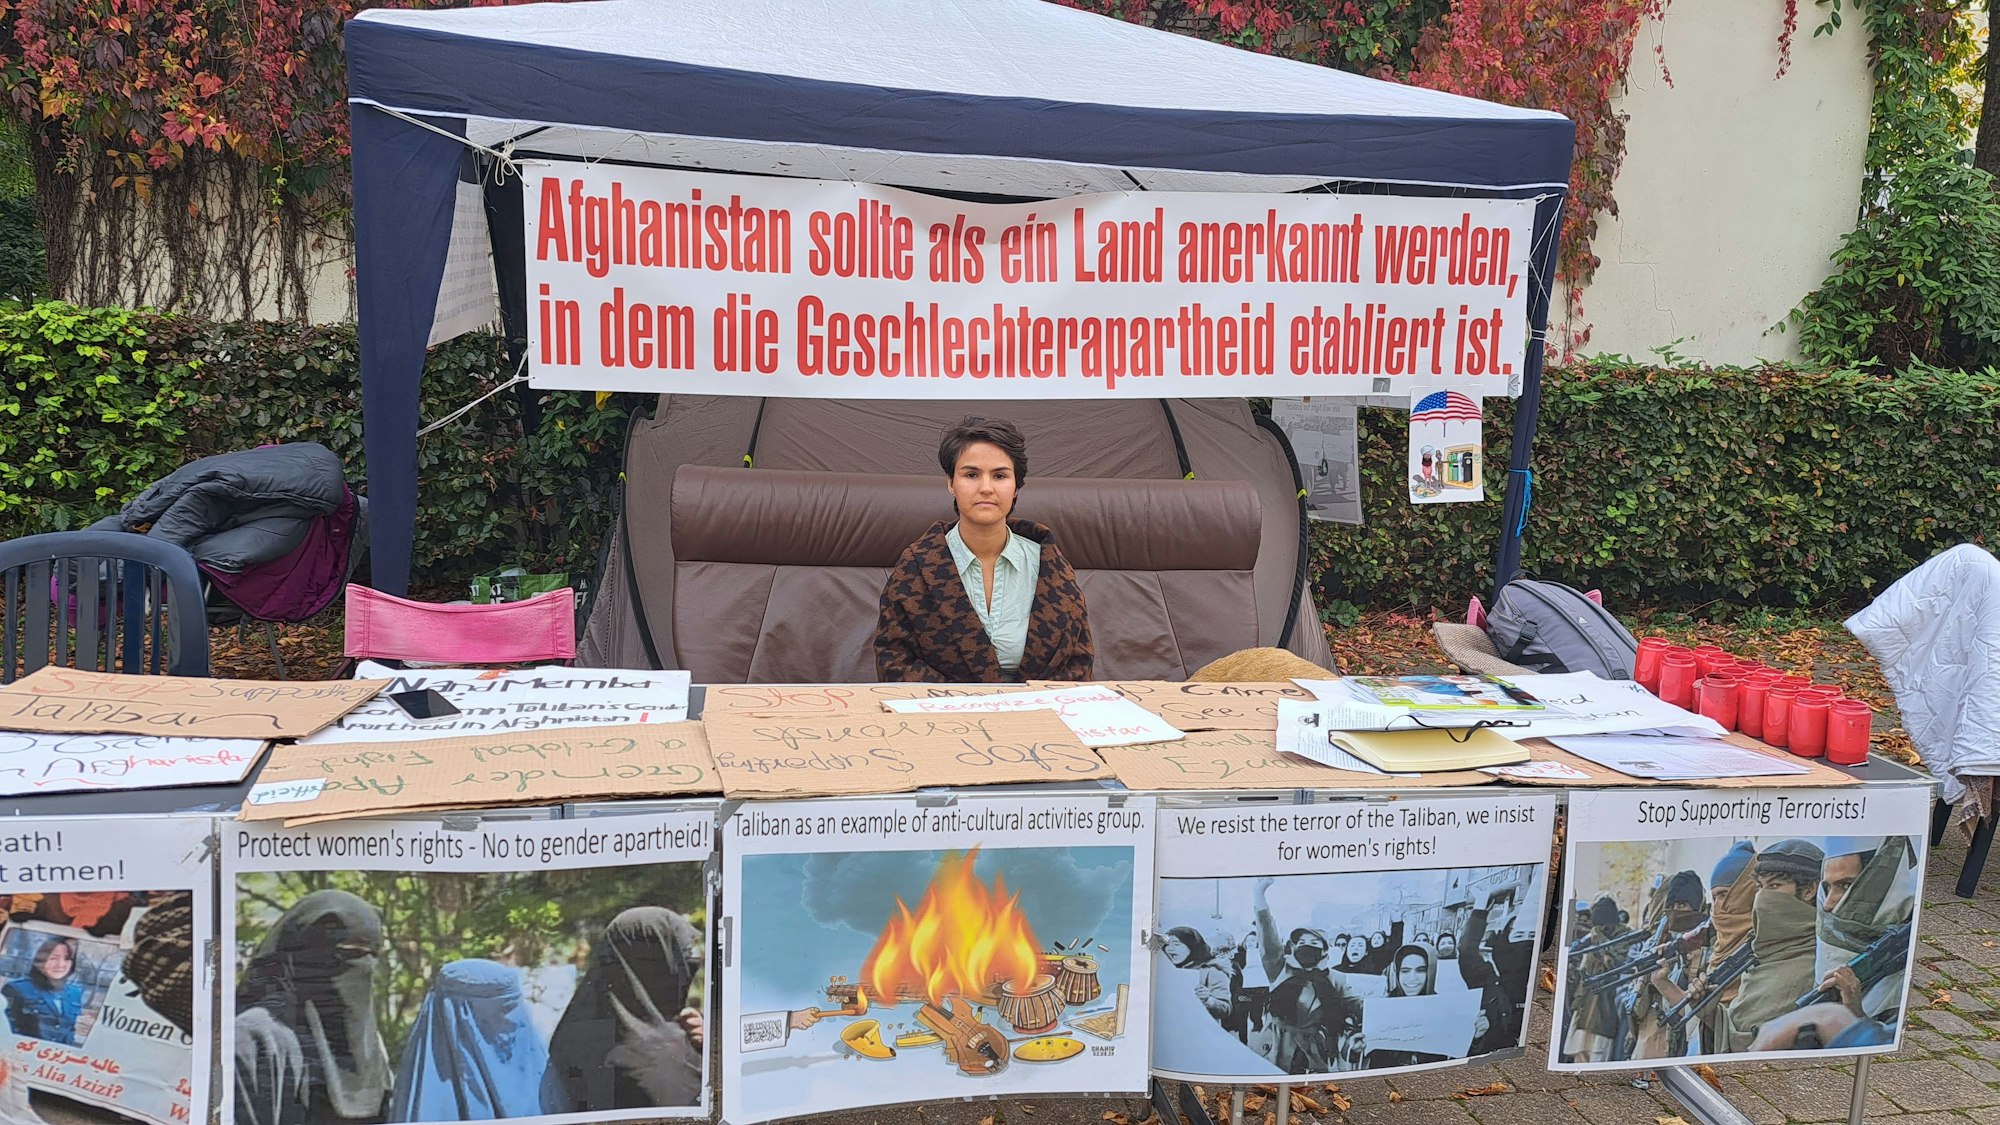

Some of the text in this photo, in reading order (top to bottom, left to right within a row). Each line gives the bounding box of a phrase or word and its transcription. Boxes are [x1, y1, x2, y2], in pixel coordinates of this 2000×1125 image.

[537, 177, 791, 278] Afghanistan
[809, 198, 914, 281] sollte
[929, 214, 986, 284] als
[1001, 213, 1057, 284] ein
[1074, 207, 1163, 283] Land
[1178, 209, 1363, 283] anerkannt
[1374, 213, 1518, 297] werden,
[539, 284, 1511, 390] in dem die Geschlechterapartheid etabliert ist.
[734, 807, 1144, 839] Taliban as an example of anti-cultural activities group.
[1178, 805, 1535, 834] We resist the terror of the Taliban, we insist
[1637, 797, 1866, 827] Stop Supporting Terrorists!
[238, 831, 311, 857] Protect
[318, 829, 404, 857] women's
[411, 831, 463, 864] rights
[483, 832, 509, 858] No
[515, 833, 534, 857] to
[541, 828, 608, 863] gender
[614, 821, 708, 858] apartheid!
[1278, 836, 1436, 860] for women's rights!
[18, 860, 124, 882] atmen!
[101, 1006, 174, 1041] Women
[32, 1065, 66, 1082] Alia
[69, 1074, 123, 1098] Azizi?
